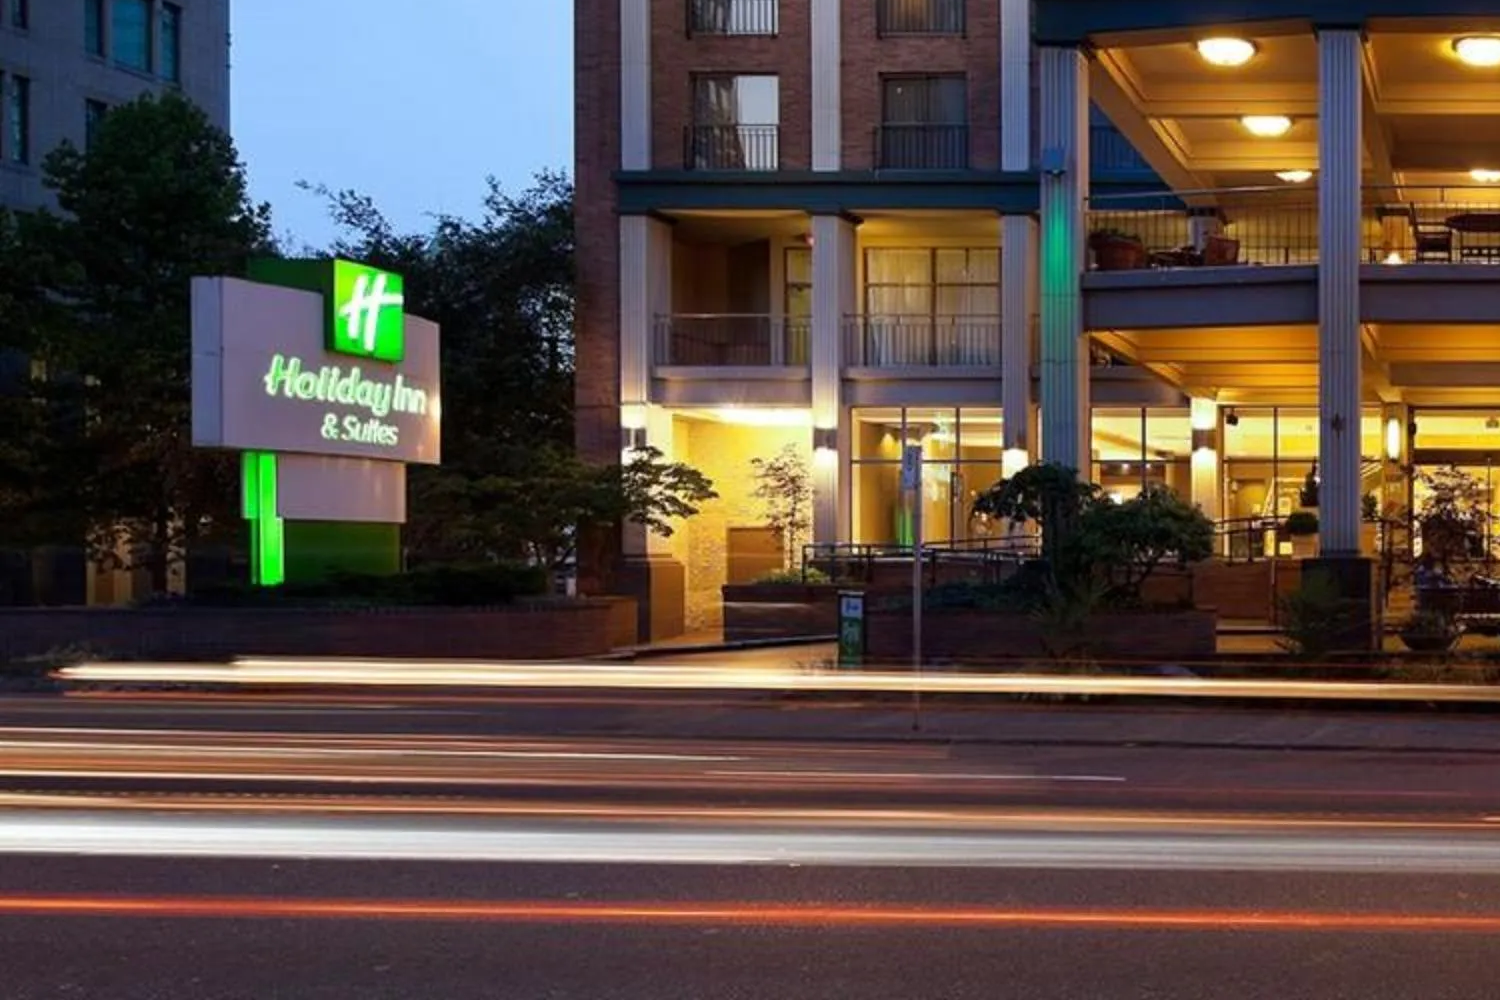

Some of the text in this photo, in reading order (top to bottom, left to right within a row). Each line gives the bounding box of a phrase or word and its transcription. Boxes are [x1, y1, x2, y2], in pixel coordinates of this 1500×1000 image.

[263, 354, 428, 417] Holiday Inn
[320, 412, 399, 446] & Suites
